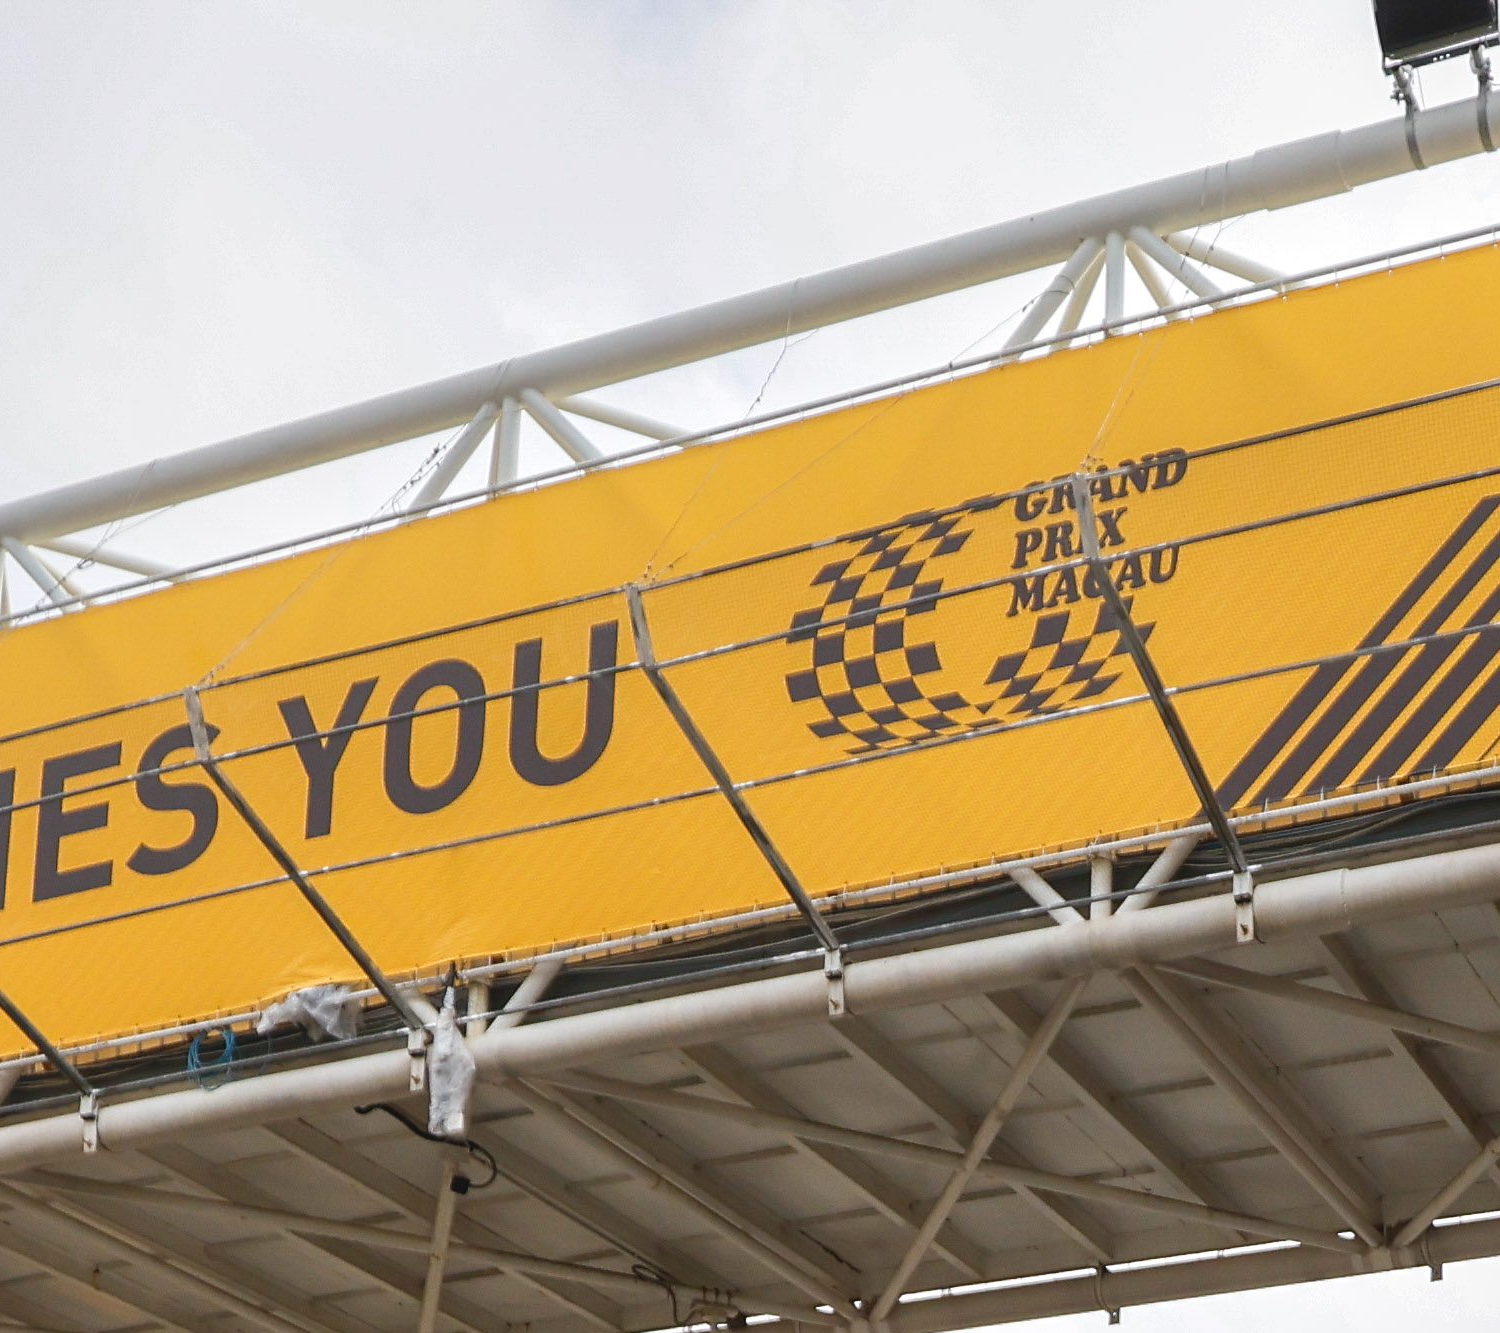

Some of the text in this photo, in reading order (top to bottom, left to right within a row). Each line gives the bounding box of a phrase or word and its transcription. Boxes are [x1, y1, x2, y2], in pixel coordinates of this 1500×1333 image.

[1012, 446, 1190, 523] GRAND
[1005, 545, 1182, 617] MACAU
[277, 619, 619, 840] YOU
